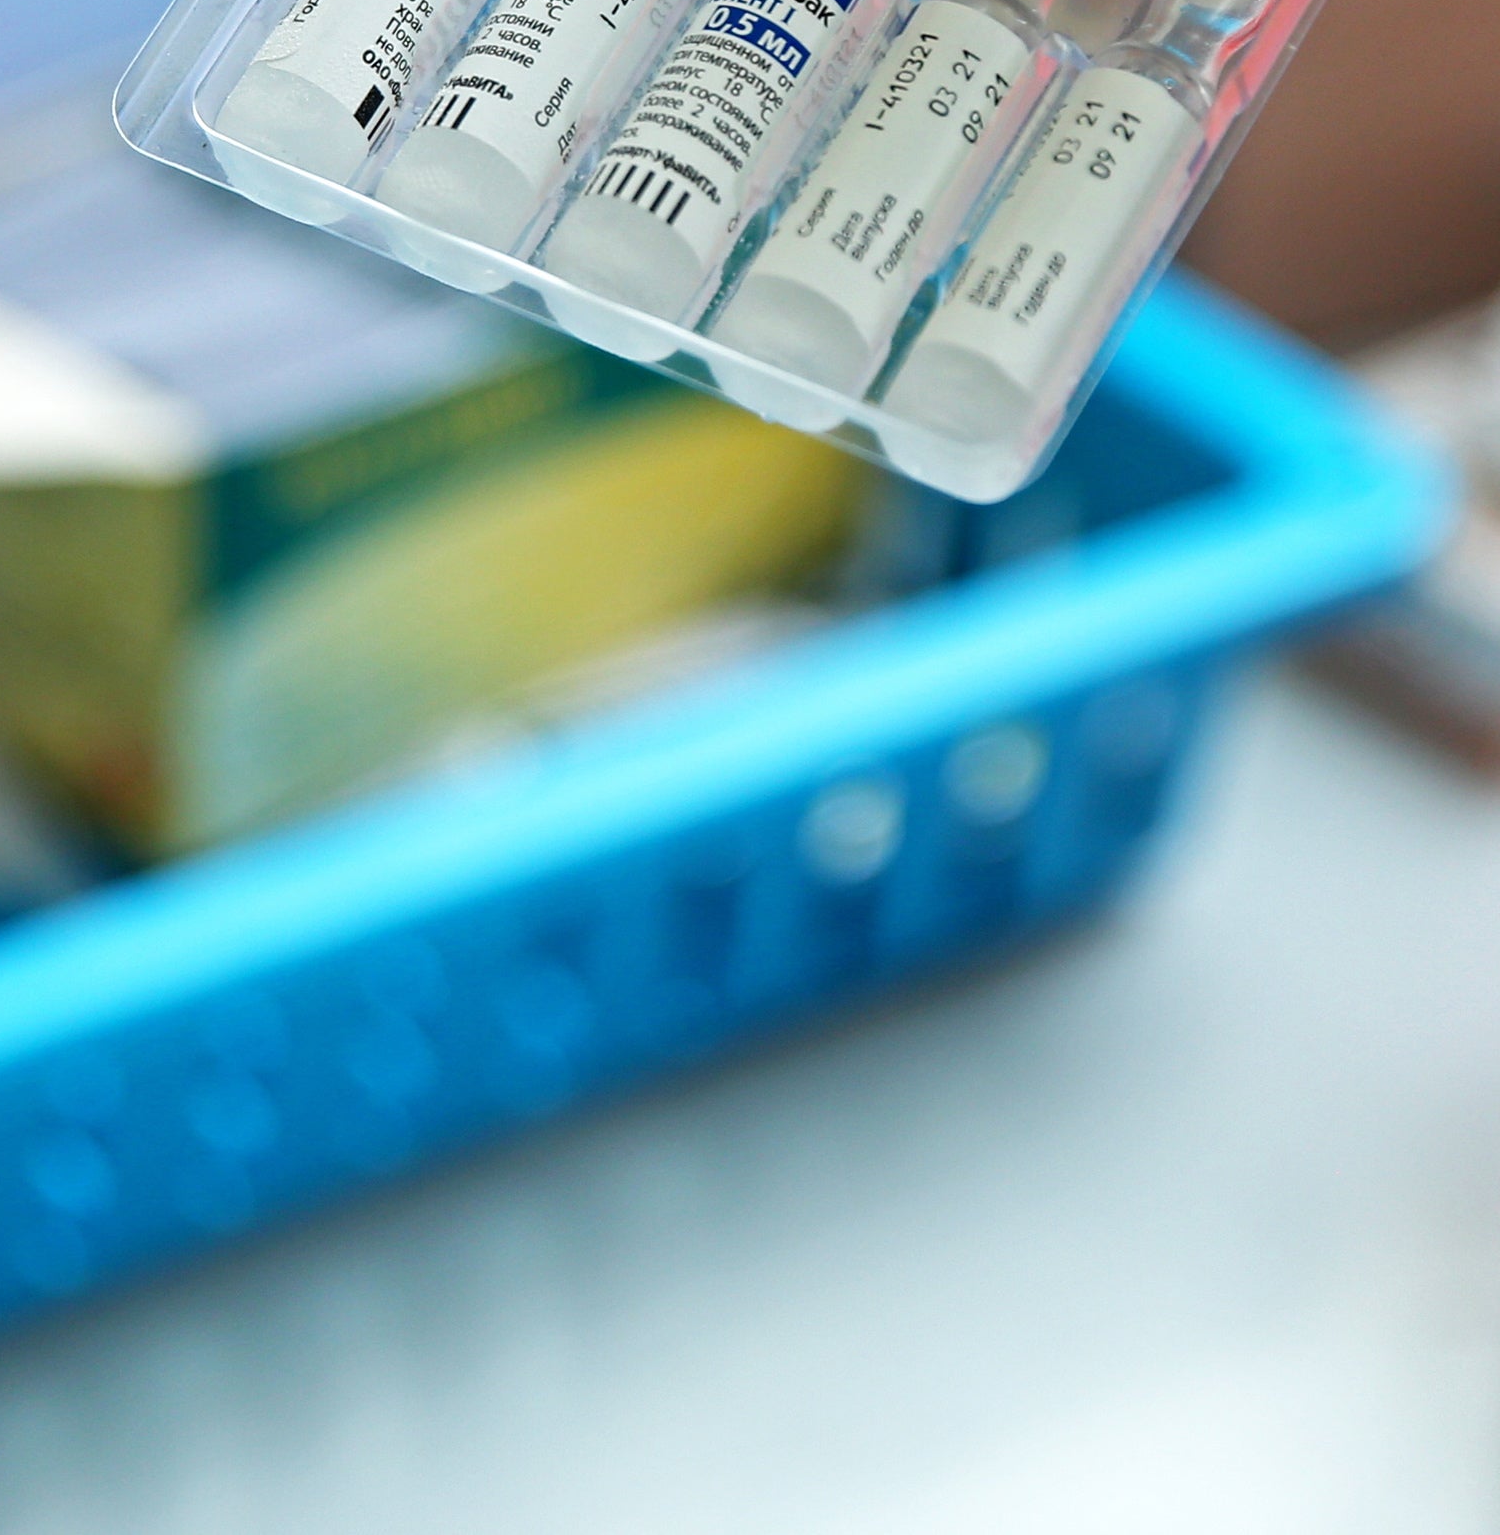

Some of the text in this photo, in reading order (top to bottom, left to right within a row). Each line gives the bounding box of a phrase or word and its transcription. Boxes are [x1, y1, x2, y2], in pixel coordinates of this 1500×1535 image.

[362, 49, 391, 80] ОАО
[375, 35, 395, 55] не
[482, 28, 541, 53] 2 часов.
[708, 6, 759, 36] 0,5
[757, 29, 803, 70] мл
[535, 77, 573, 127] Серия
[694, 50, 784, 110] температуре
[723, 78, 744, 97] 18
[777, 74, 795, 93] от
[928, 49, 982, 117] 03 21
[689, 85, 764, 141] состоянии
[691, 104, 705, 118] 2
[962, 73, 1010, 144] 09 21
[1053, 100, 1105, 165] 03 21
[1090, 112, 1141, 179] 09 21
